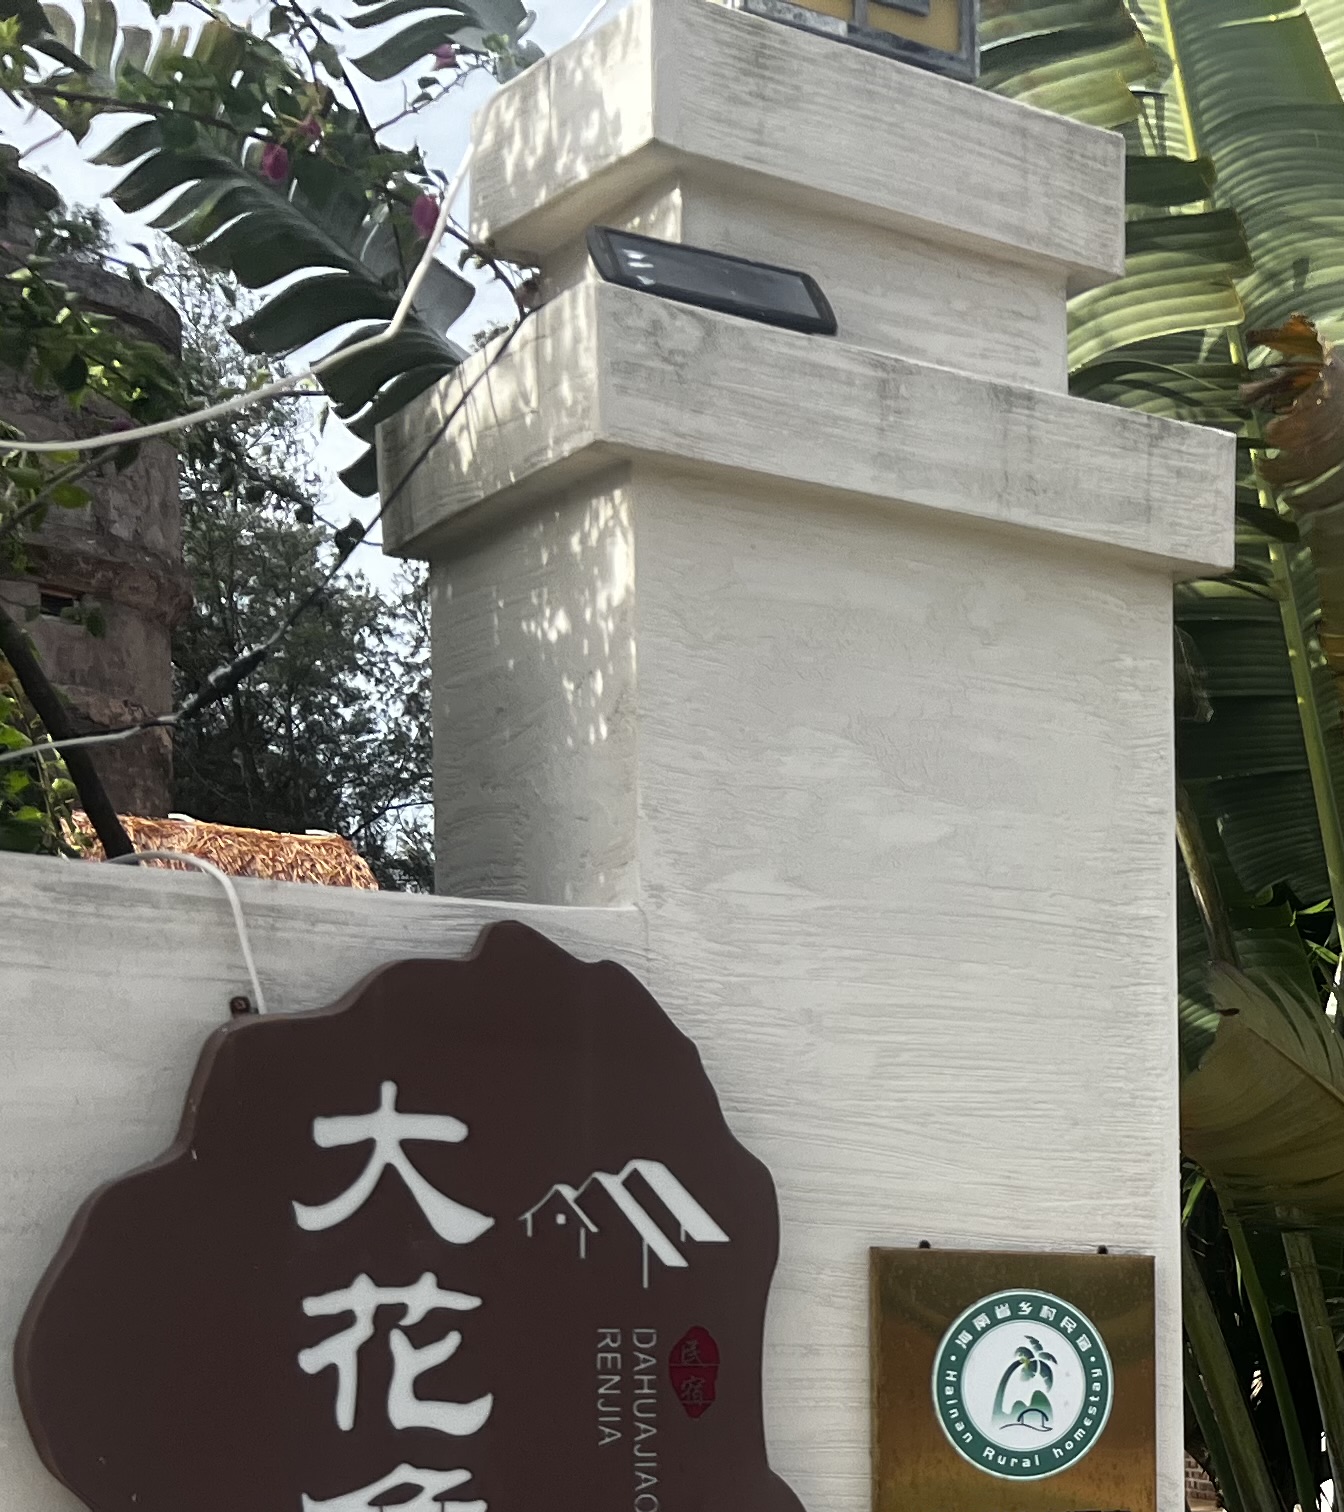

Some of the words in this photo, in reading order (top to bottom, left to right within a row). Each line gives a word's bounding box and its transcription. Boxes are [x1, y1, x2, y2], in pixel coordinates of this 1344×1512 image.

[596, 1328, 622, 1446] RENJIA
[982, 1446, 1040, 1468] Rural
[1052, 1368, 1103, 1459] homestay
